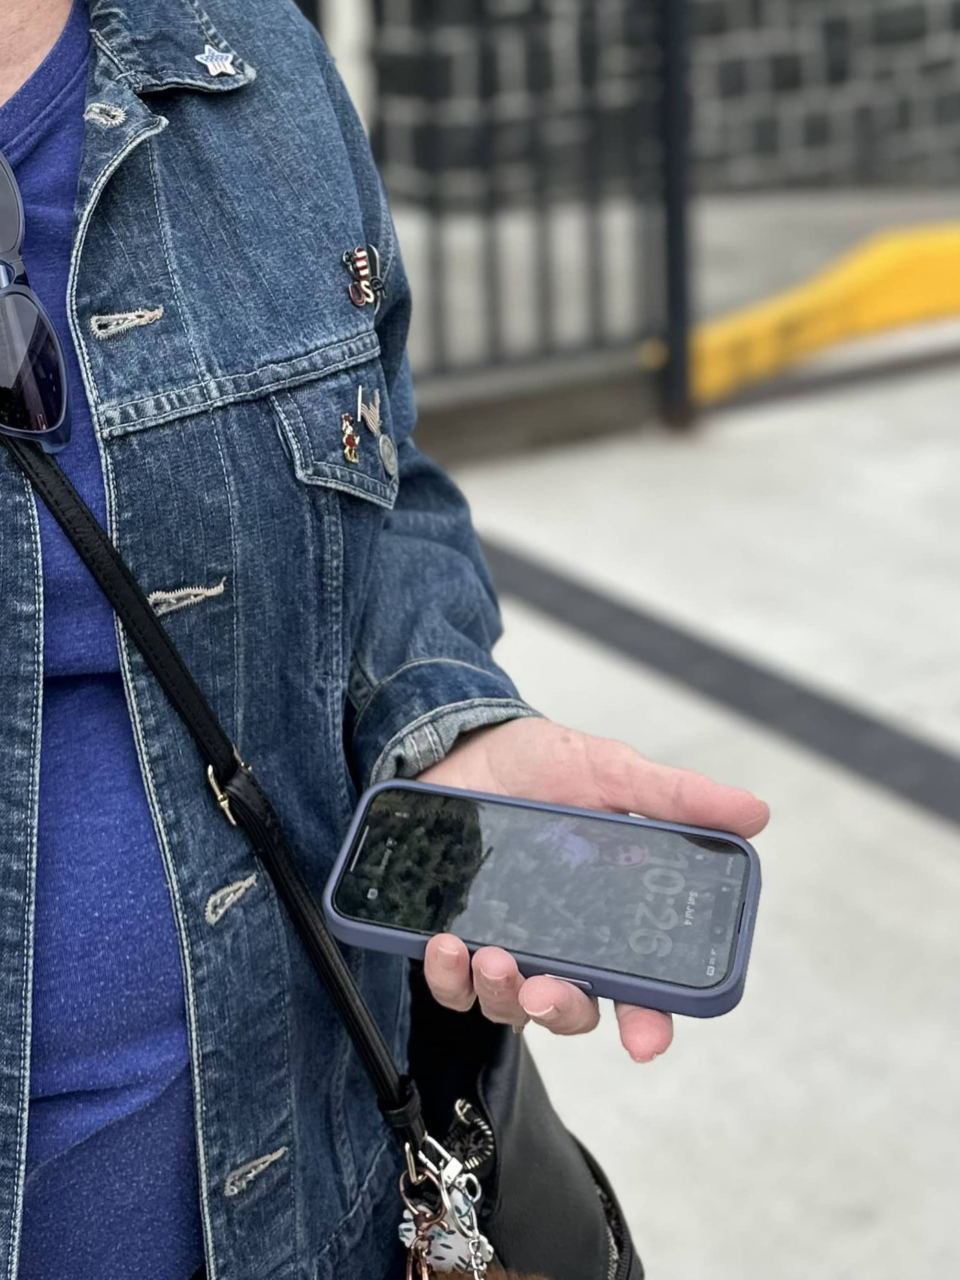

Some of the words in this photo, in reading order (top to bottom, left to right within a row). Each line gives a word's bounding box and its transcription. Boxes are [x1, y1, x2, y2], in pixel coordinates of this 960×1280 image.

[628, 853, 689, 957] 10:26
[687, 891, 698, 905] Sat
[684, 905, 695, 919] Jul
